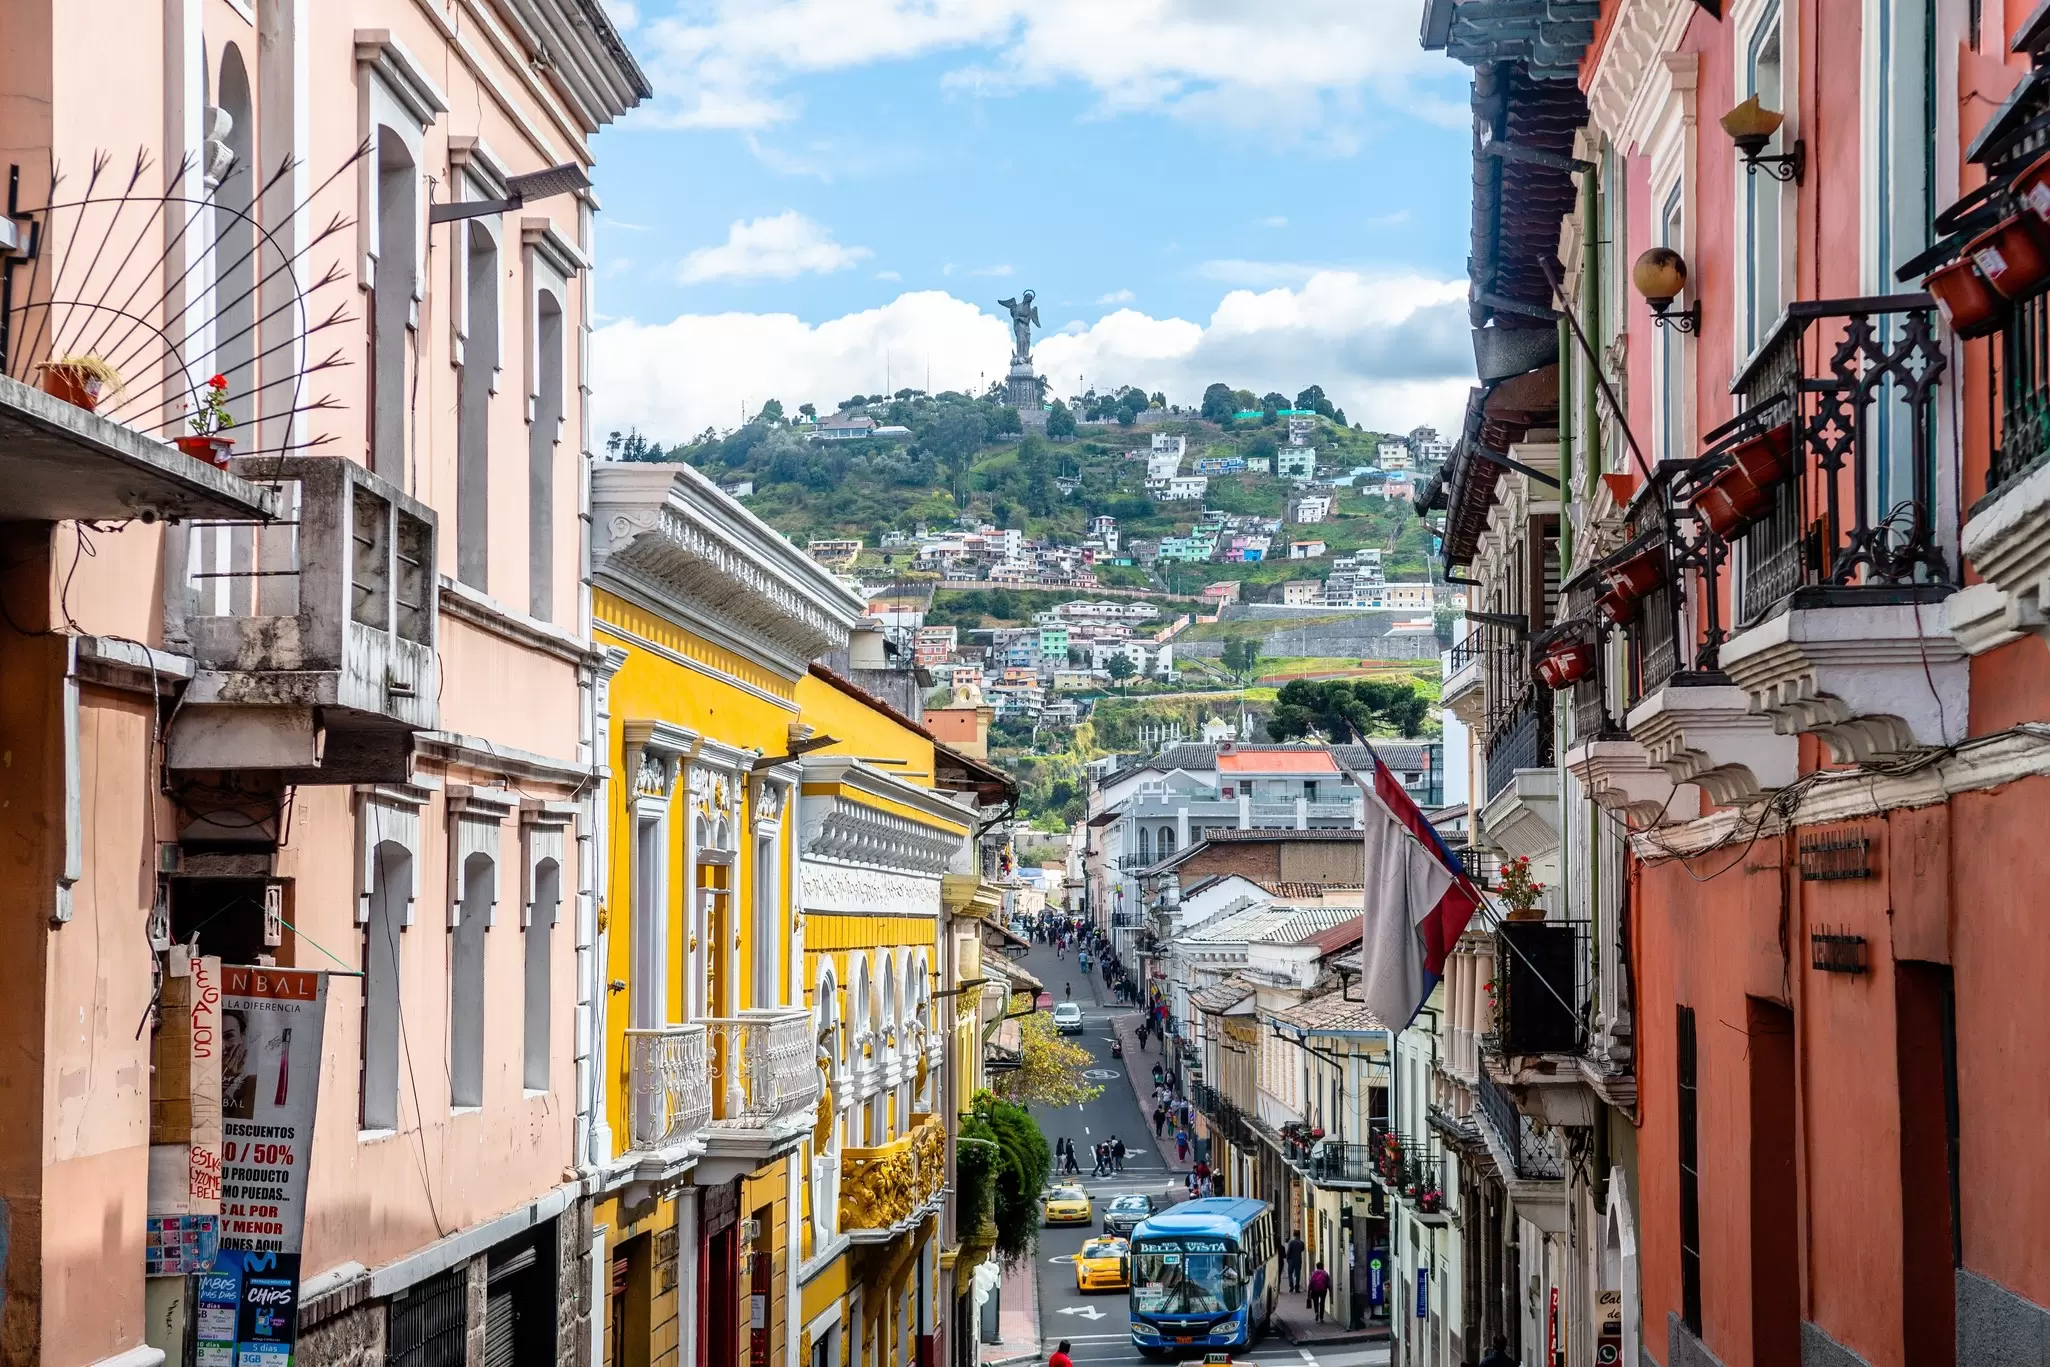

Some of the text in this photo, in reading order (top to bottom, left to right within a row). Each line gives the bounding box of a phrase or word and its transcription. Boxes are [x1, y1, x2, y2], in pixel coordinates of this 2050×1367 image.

[220, 974, 308, 995] NBAL
[190, 958, 219, 1058] REGALOS
[228, 1001, 240, 1009] LA
[243, 1001, 301, 1013] DIFERENCIA
[225, 1123, 295, 1139] DESCUENTOS
[253, 1144, 294, 1165] 50%
[190, 1166, 221, 1190] CYZONE
[231, 1167, 289, 1183] PRODUCTO
[241, 1186, 290, 1201] PUEDAS...
[229, 1204, 246, 1216] AL
[249, 1205, 279, 1218] POR
[221, 1220, 283, 1235] Y MENOR
[255, 1239, 283, 1252] AQUI
[1140, 1242, 1227, 1252] BELLA VISTA
[200, 1276, 237, 1291] MBOS
[1600, 1292, 1621, 1307] Cal
[1607, 1308, 1621, 1319] de
[243, 1354, 262, 1363] 3GB
